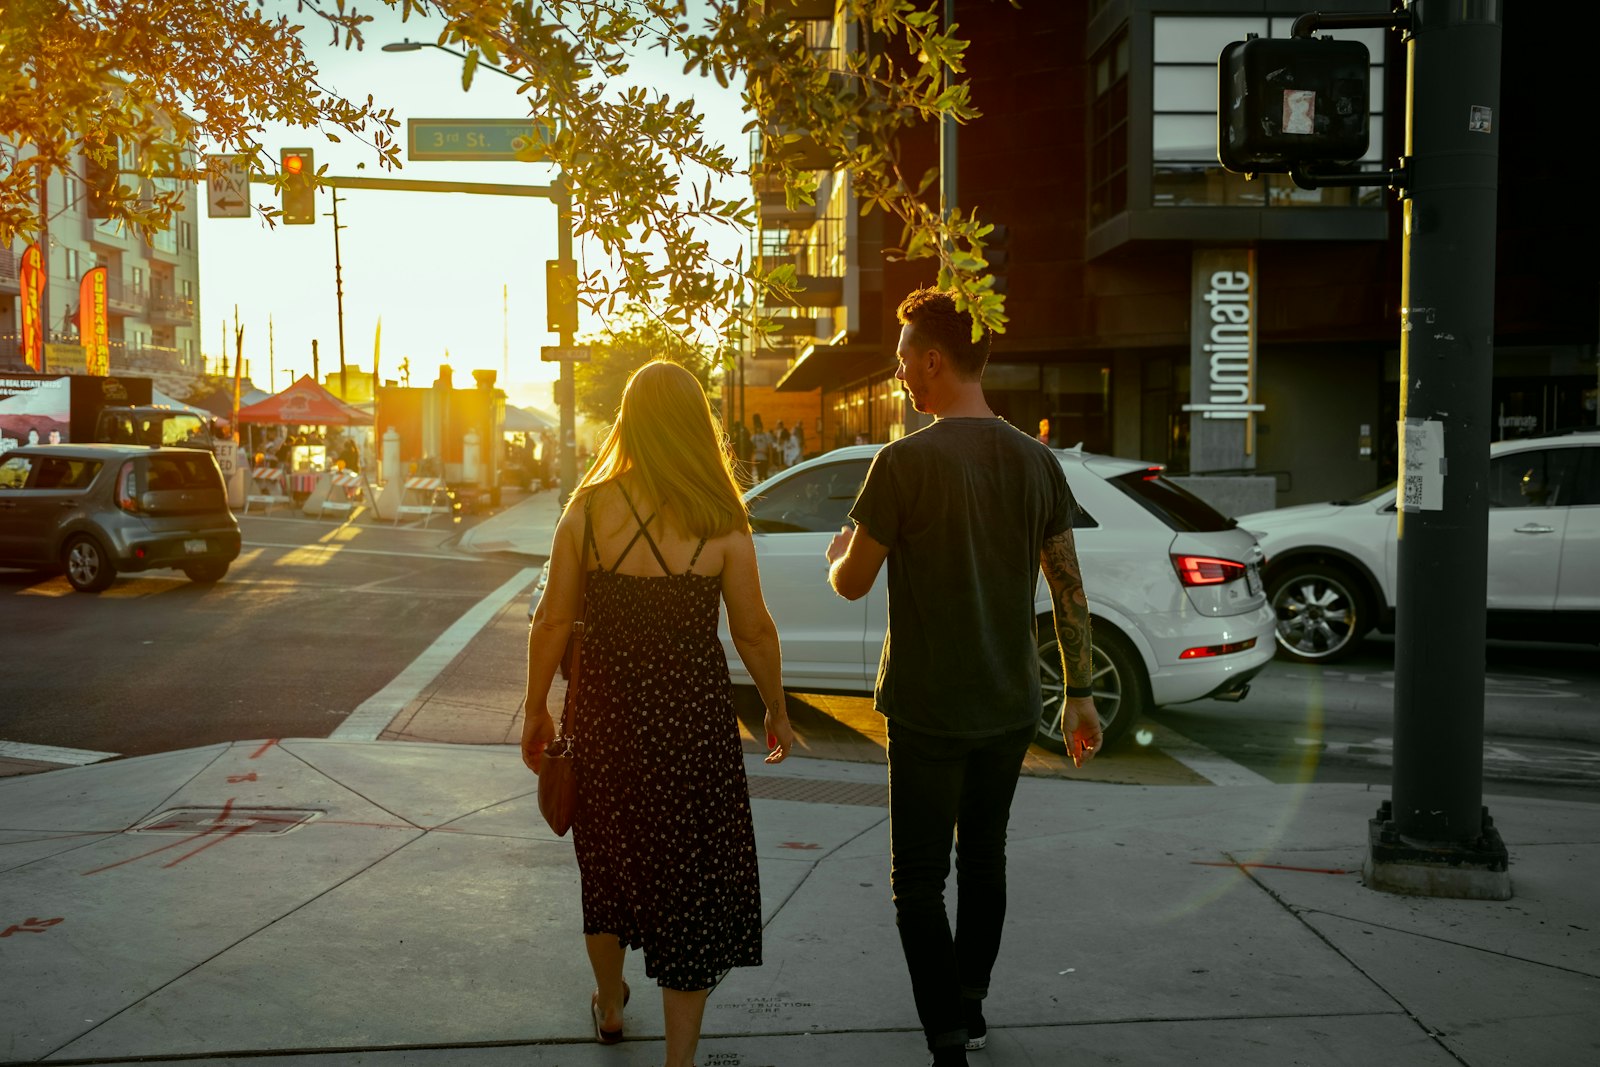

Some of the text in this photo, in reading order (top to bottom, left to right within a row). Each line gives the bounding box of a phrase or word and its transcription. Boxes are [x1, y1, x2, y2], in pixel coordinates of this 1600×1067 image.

[432, 131, 491, 148] 3rd St.
[213, 179, 245, 192] WAY
